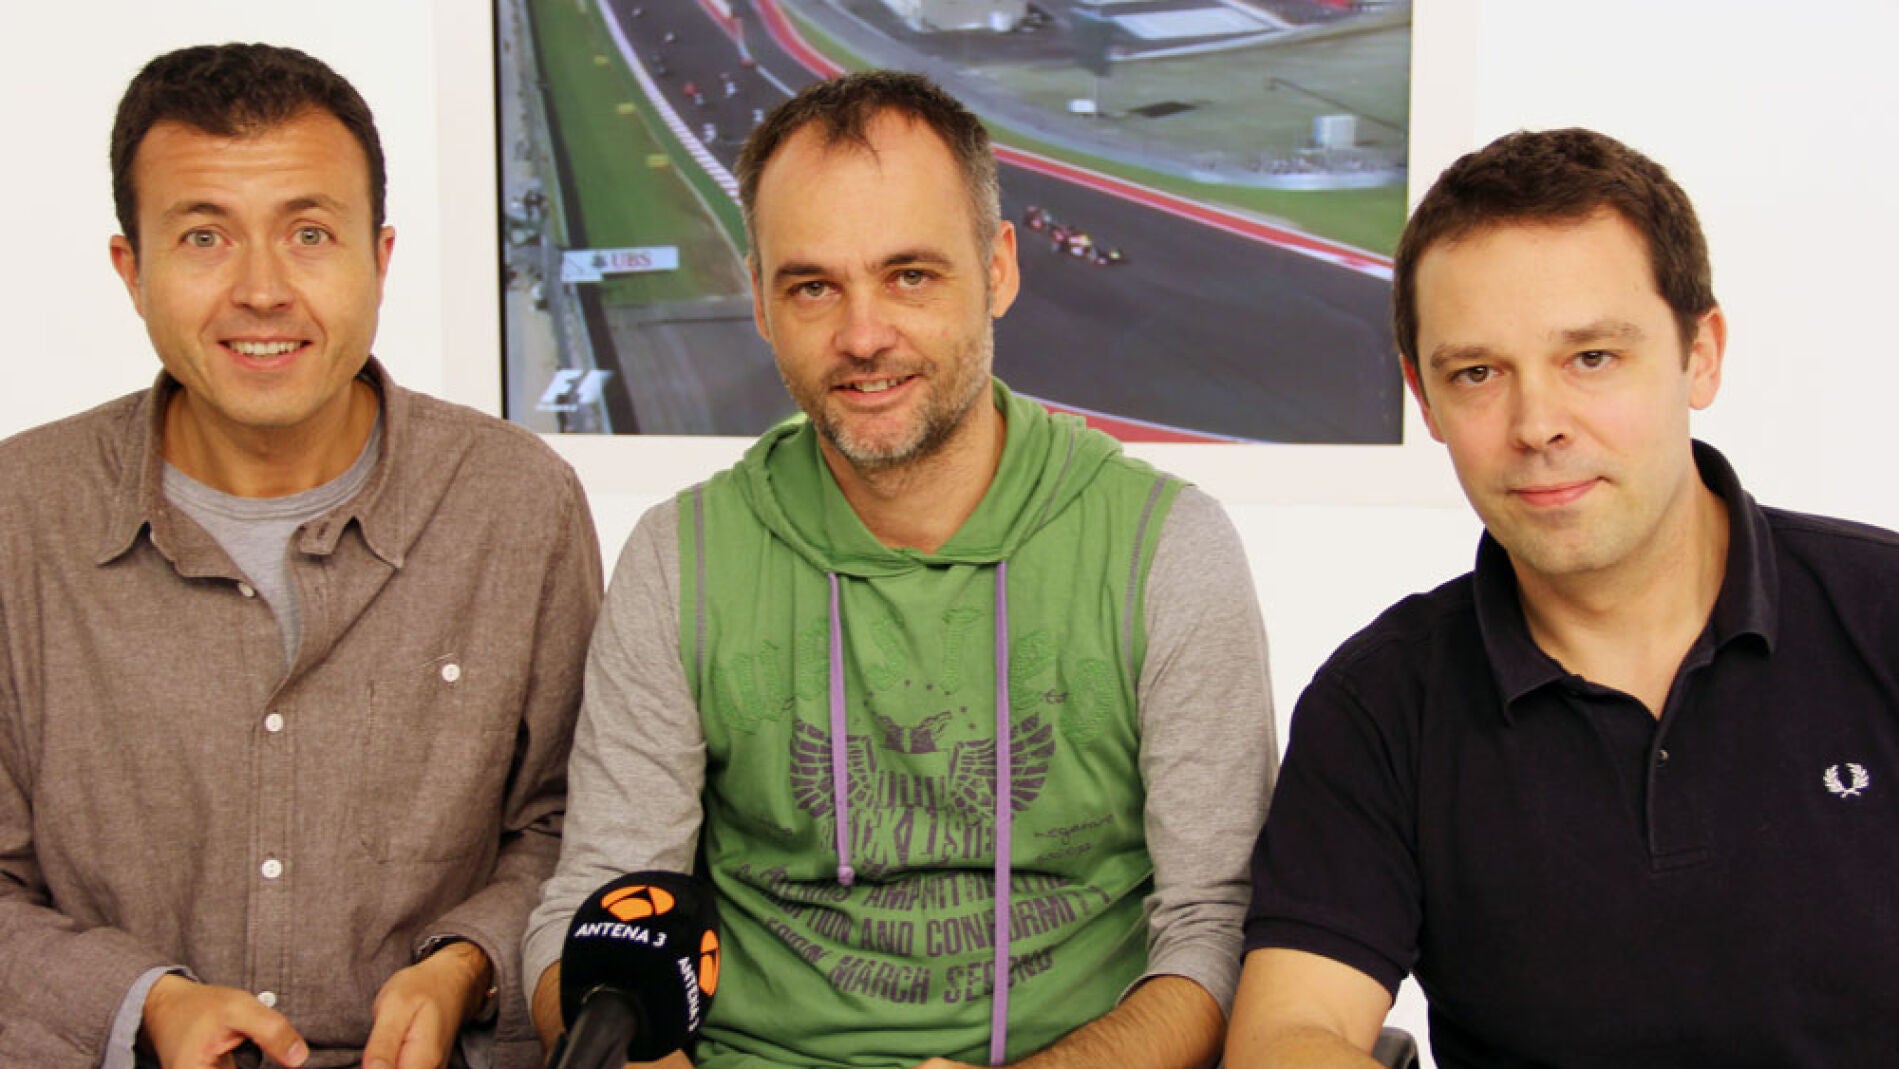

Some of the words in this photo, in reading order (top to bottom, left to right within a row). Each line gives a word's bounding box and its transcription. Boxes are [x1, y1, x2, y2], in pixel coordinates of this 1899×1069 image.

[611, 253, 651, 269] UBS
[574, 921, 650, 944] ANTENA
[652, 931, 668, 949] 3
[861, 917, 914, 958] AND
[677, 956, 700, 1021] ANTENA
[828, 954, 930, 1004] MARCH
